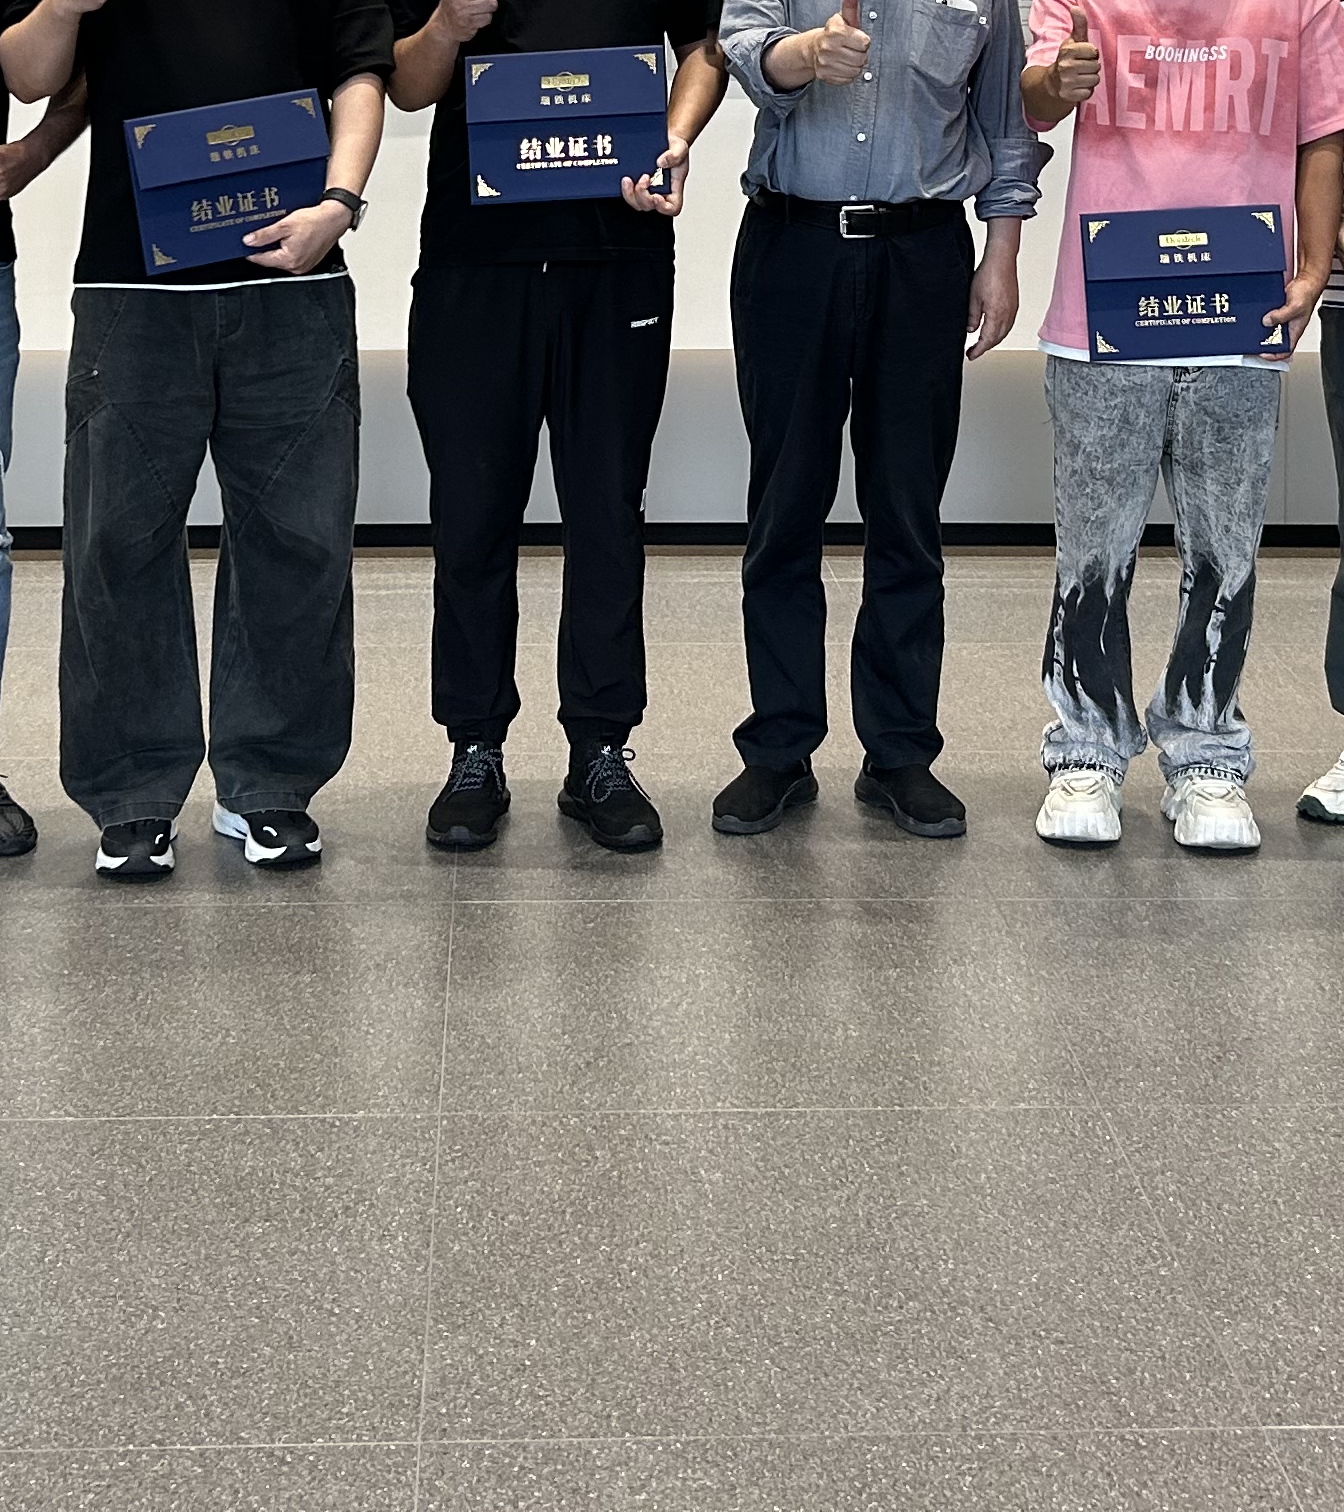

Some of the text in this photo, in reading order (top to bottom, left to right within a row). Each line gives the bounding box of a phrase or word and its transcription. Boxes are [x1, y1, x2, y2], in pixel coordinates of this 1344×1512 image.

[520, 134, 612, 161] 结业证书
[191, 186, 279, 222] 结业证书
[1138, 293, 1229, 317] 结业证书
